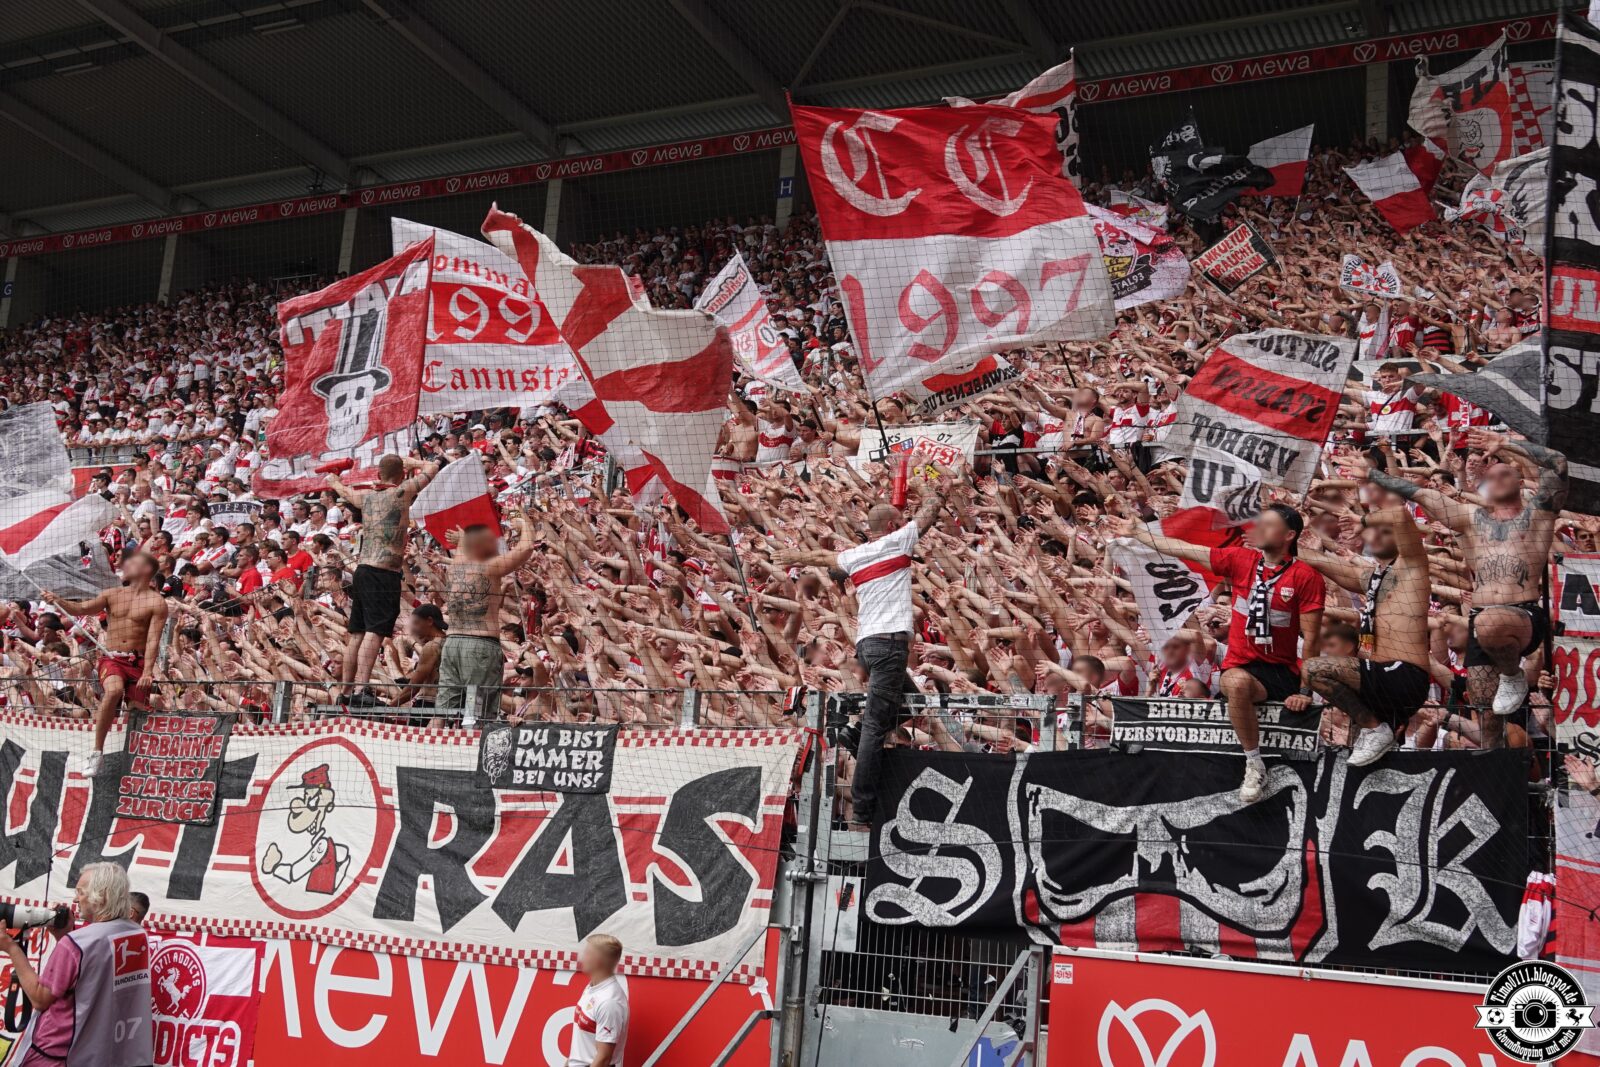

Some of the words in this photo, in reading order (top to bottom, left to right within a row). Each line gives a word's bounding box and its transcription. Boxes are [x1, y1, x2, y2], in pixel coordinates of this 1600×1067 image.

[781, 180, 792, 194] H
[1209, 243, 1254, 279] BRAUCHT
[4, 284, 12, 295] G
[840, 253, 1092, 374] 1997
[937, 433, 952, 443] 07
[1147, 702, 1206, 720] EHRE
[142, 716, 217, 734] JEDER
[128, 731, 224, 758] VERBANNTE
[518, 729, 549, 746] DU
[558, 730, 609, 748] BIST
[1259, 732, 1315, 751] LTRAS
[131, 756, 210, 778] KEHRT
[515, 747, 604, 771] IMMER
[513, 770, 546, 785] BEI
[554, 770, 604, 788] UNS!
[116, 796, 211, 821] ZURÜCK
[173, 952, 200, 987] ADDICTS
[114, 973, 148, 987] BUNDESLIGA
[114, 1017, 143, 1043] 07
